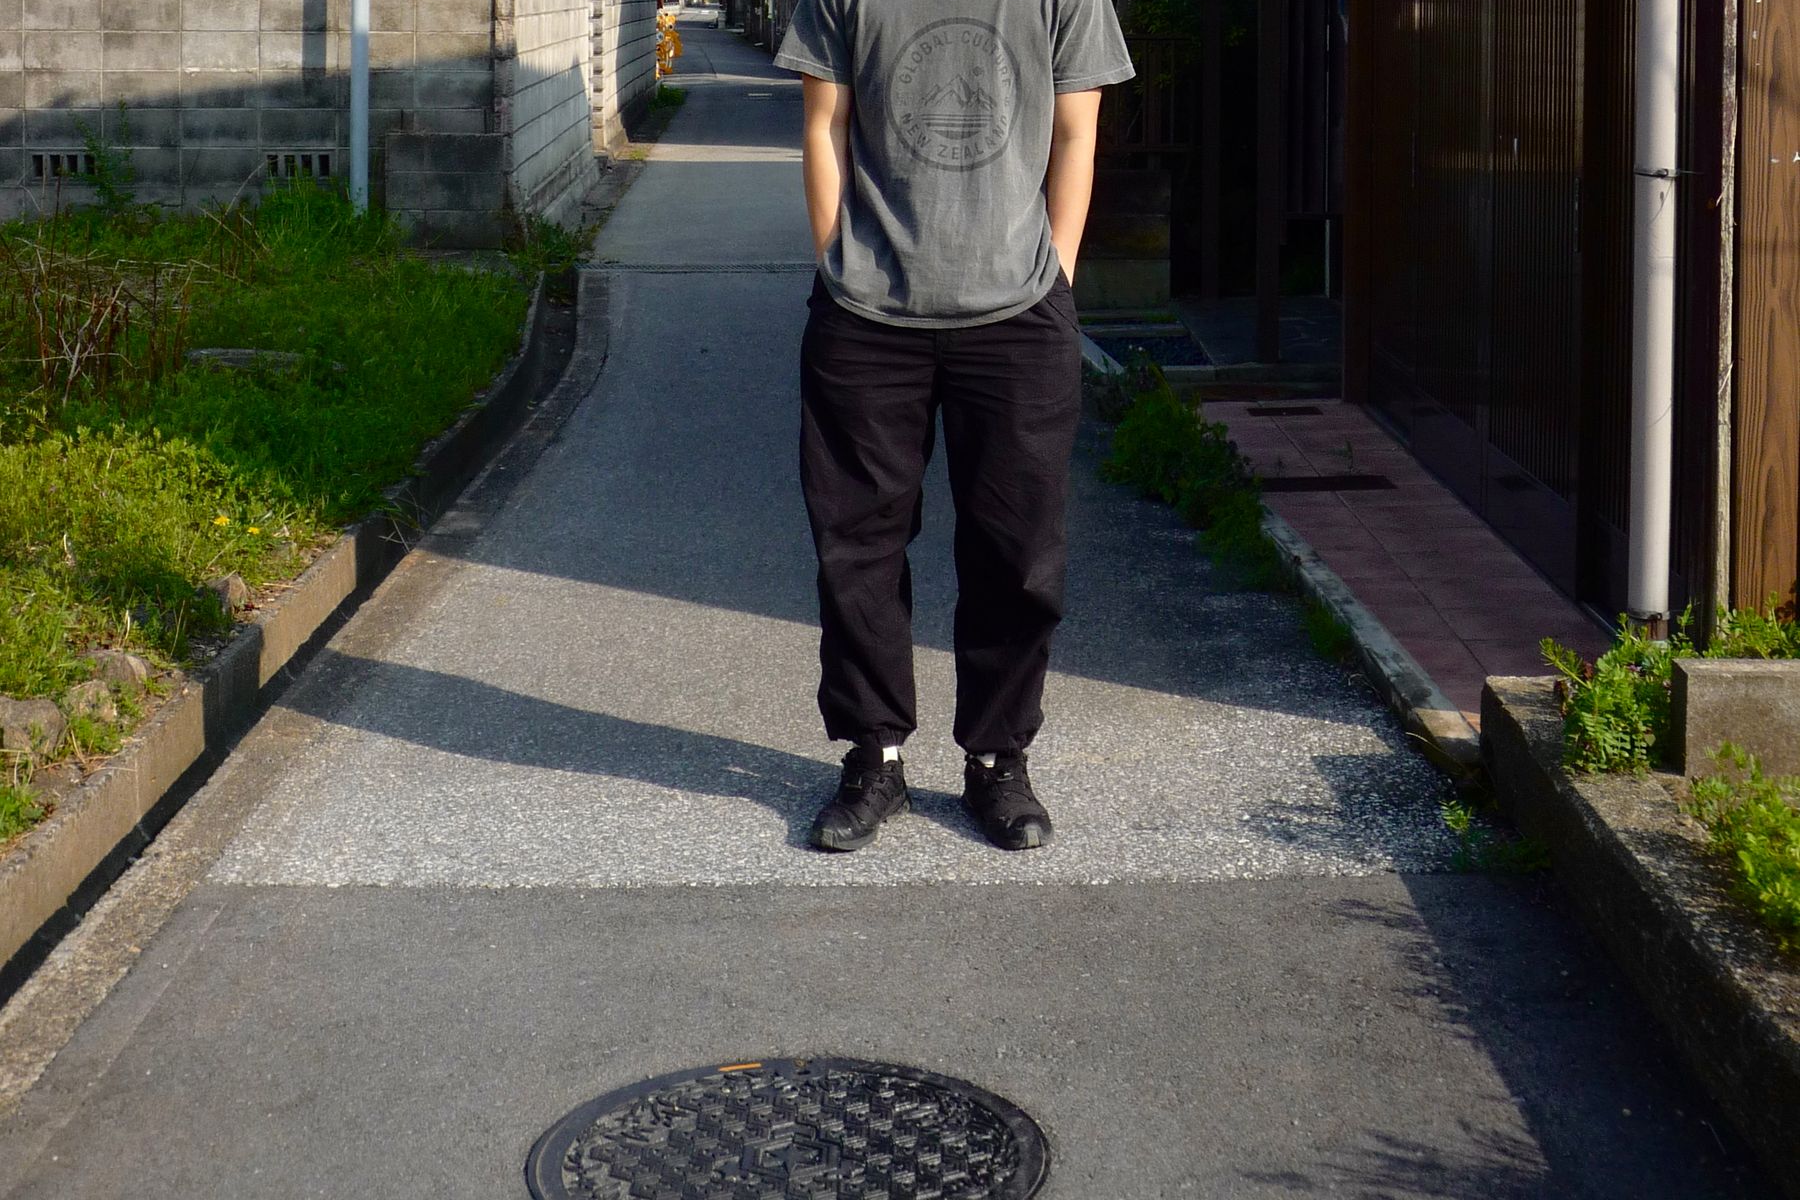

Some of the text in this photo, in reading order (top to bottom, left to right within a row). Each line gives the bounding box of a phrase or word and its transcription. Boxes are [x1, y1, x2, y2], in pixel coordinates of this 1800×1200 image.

[899, 30, 1011, 87] GLOBAL CULTURE
[901, 112, 1009, 160] NEW ZEALAND
